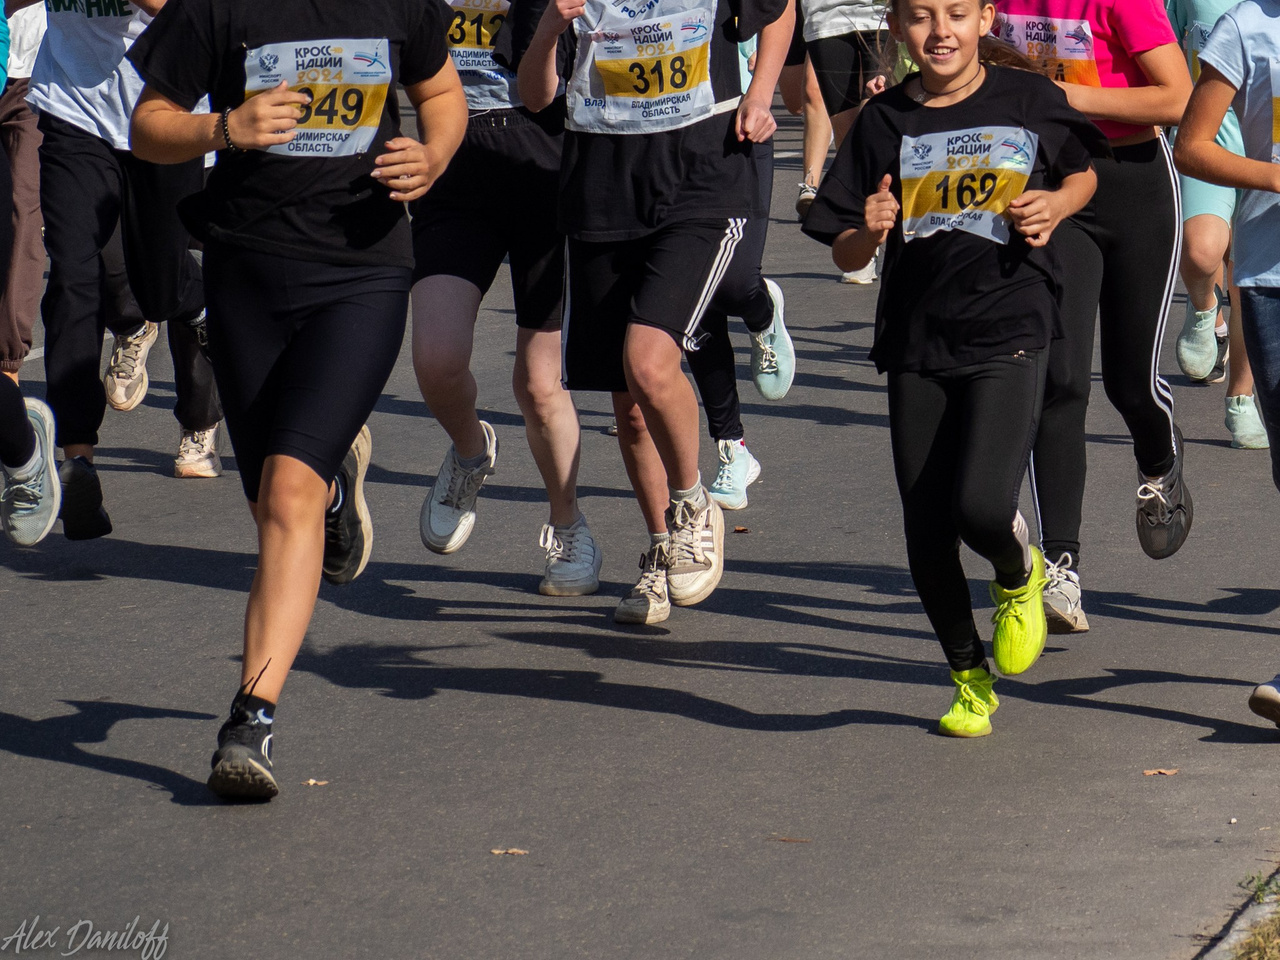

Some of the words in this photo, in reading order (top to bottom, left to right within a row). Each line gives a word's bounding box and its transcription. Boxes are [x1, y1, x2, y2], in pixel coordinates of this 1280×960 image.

[449, 11, 505, 46] 312
[630, 23, 662, 35] КРОСС
[1025, 21, 1052, 31] КРОСС
[633, 31, 673, 45] НАЦИИ
[1025, 31, 1057, 44] НАЦИИ
[295, 45, 331, 58] КРОСС
[637, 43, 676, 58] 2024
[296, 57, 343, 71] НАЦИИ
[296, 68, 343, 84] 2024
[628, 56, 687, 94] 318
[631, 93, 691, 109] ВЛАДИМИРСКАЯ
[641, 106, 681, 118] ОБЛАСТЬ
[947, 133, 982, 146] КРОСС
[288, 143, 333, 153] ОБЛАСТЬ
[946, 144, 992, 156] НАЦИИ
[946, 155, 991, 170] 2024
[935, 173, 998, 211] 169
